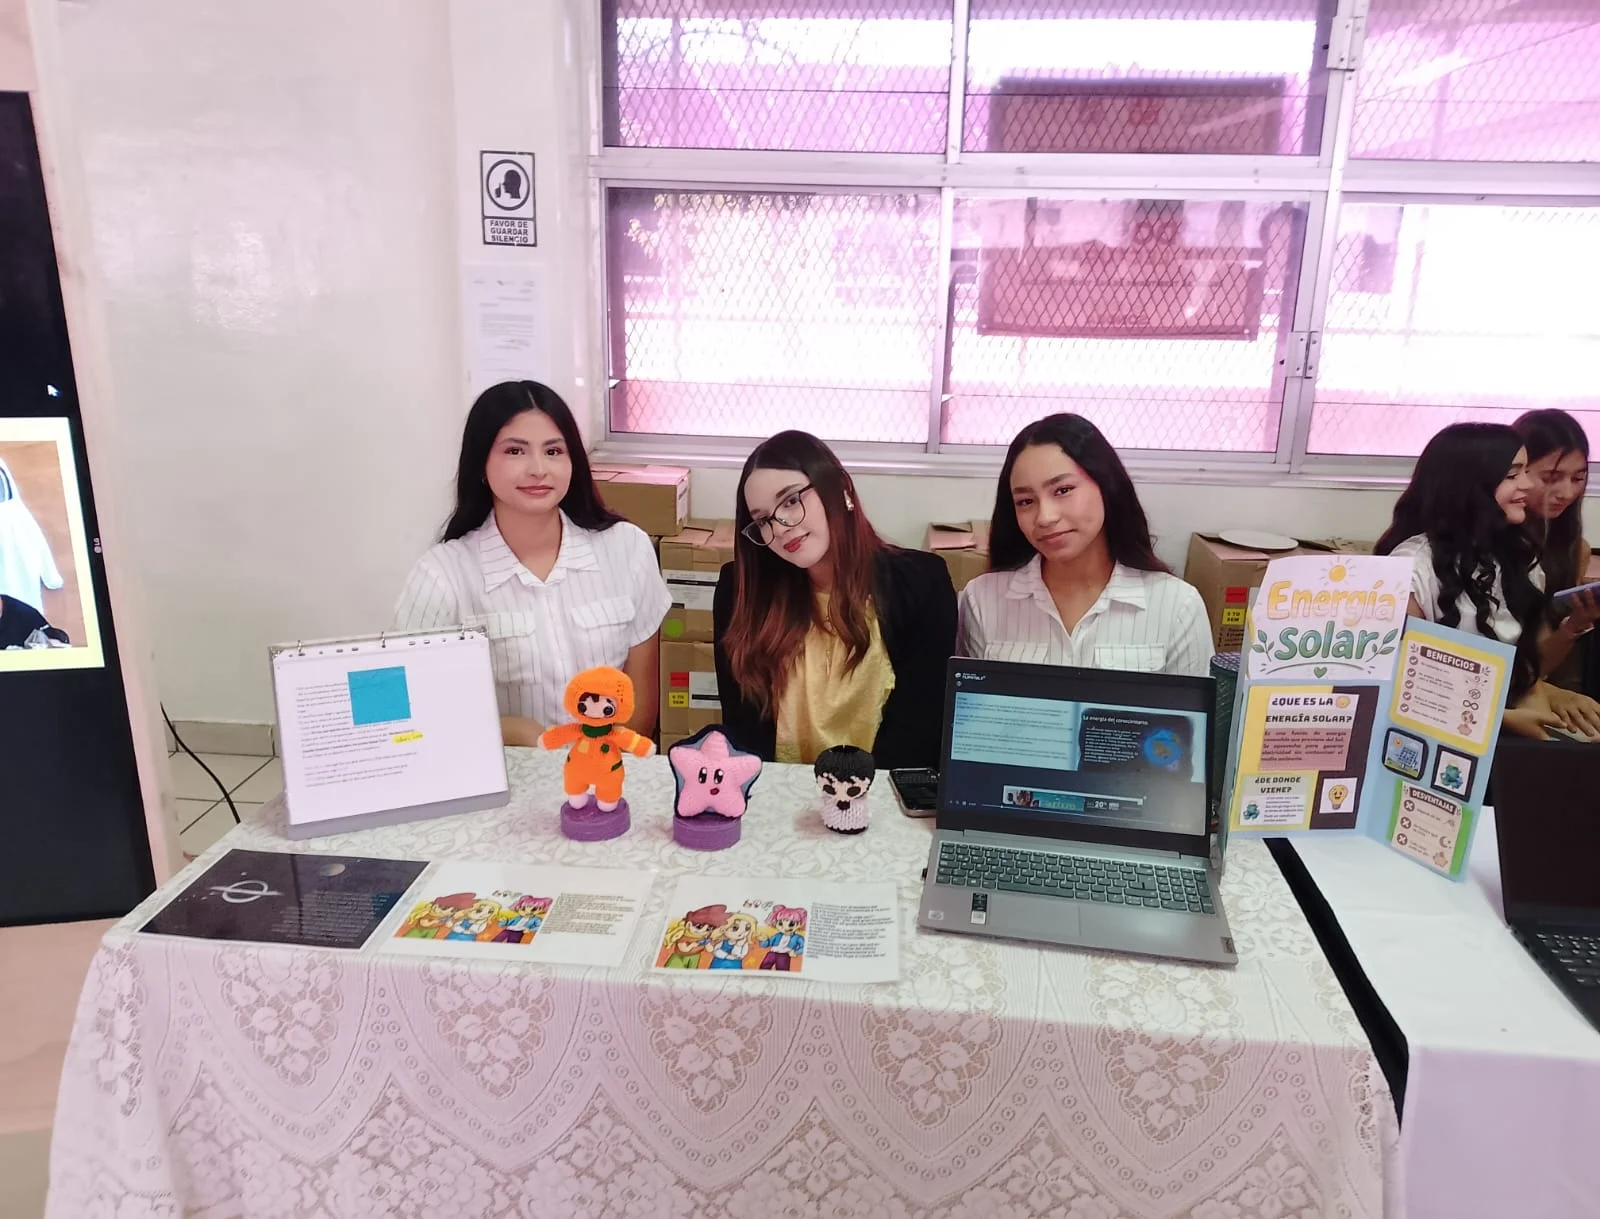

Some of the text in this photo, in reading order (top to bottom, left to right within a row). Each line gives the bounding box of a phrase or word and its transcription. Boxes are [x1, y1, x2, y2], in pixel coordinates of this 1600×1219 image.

[491, 235, 528, 243] SILENCIO
[1266, 579, 1397, 627] Energía
[1426, 649, 1475, 671] BENEFICIOS
[1303, 697, 1316, 706] ES
[1318, 697, 1334, 706] LA
[1265, 713, 1352, 723] ENERGÍA SOLAR?
[1272, 776, 1301, 784] DONDE
[1260, 786, 1292, 794] VIENE?
[1412, 790, 1454, 812] DESVENTAJAS
